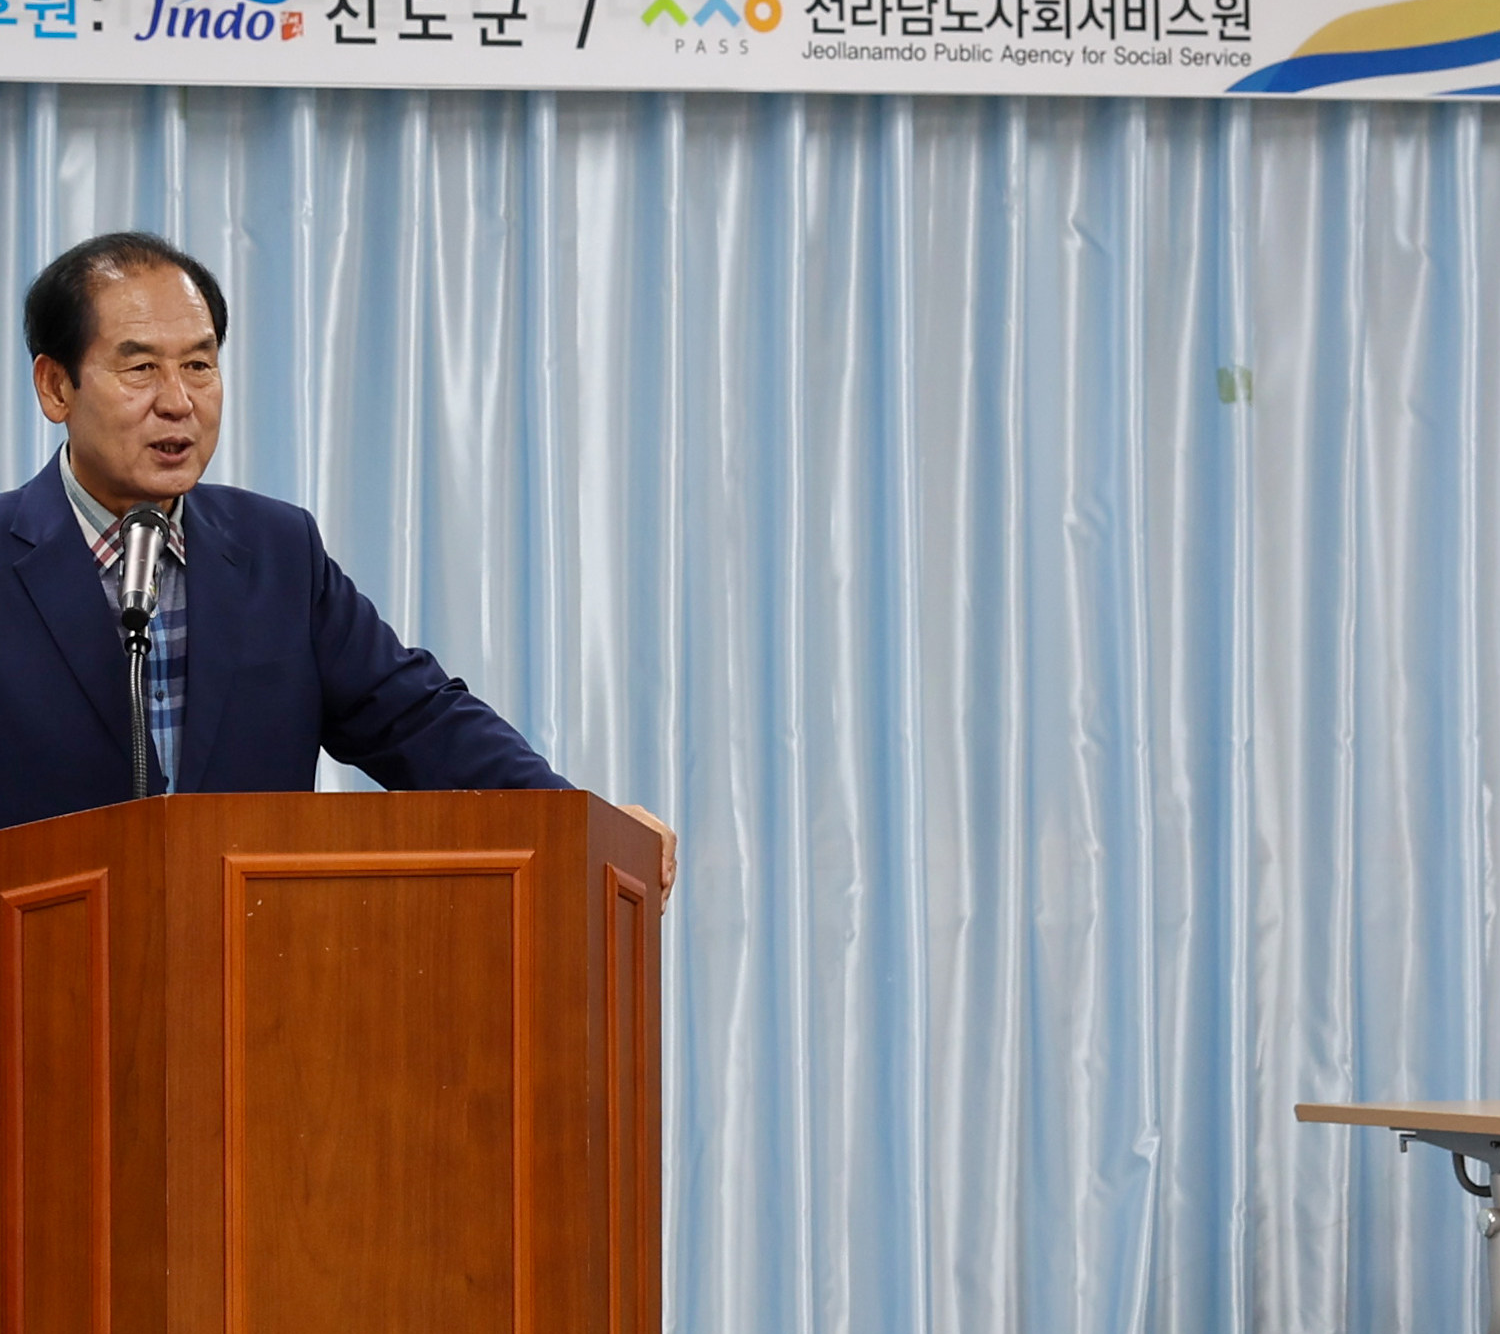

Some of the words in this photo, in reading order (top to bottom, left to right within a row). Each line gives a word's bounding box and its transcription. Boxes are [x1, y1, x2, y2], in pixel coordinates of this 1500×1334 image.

[676, 40, 748, 54] PASS
[803, 42, 926, 61] Jeollanamdo
[935, 43, 992, 62] Public
[1001, 45, 1073, 66] Agency
[1082, 47, 1105, 64] for
[1115, 46, 1171, 65] Social
[1181, 47, 1251, 66] Service
